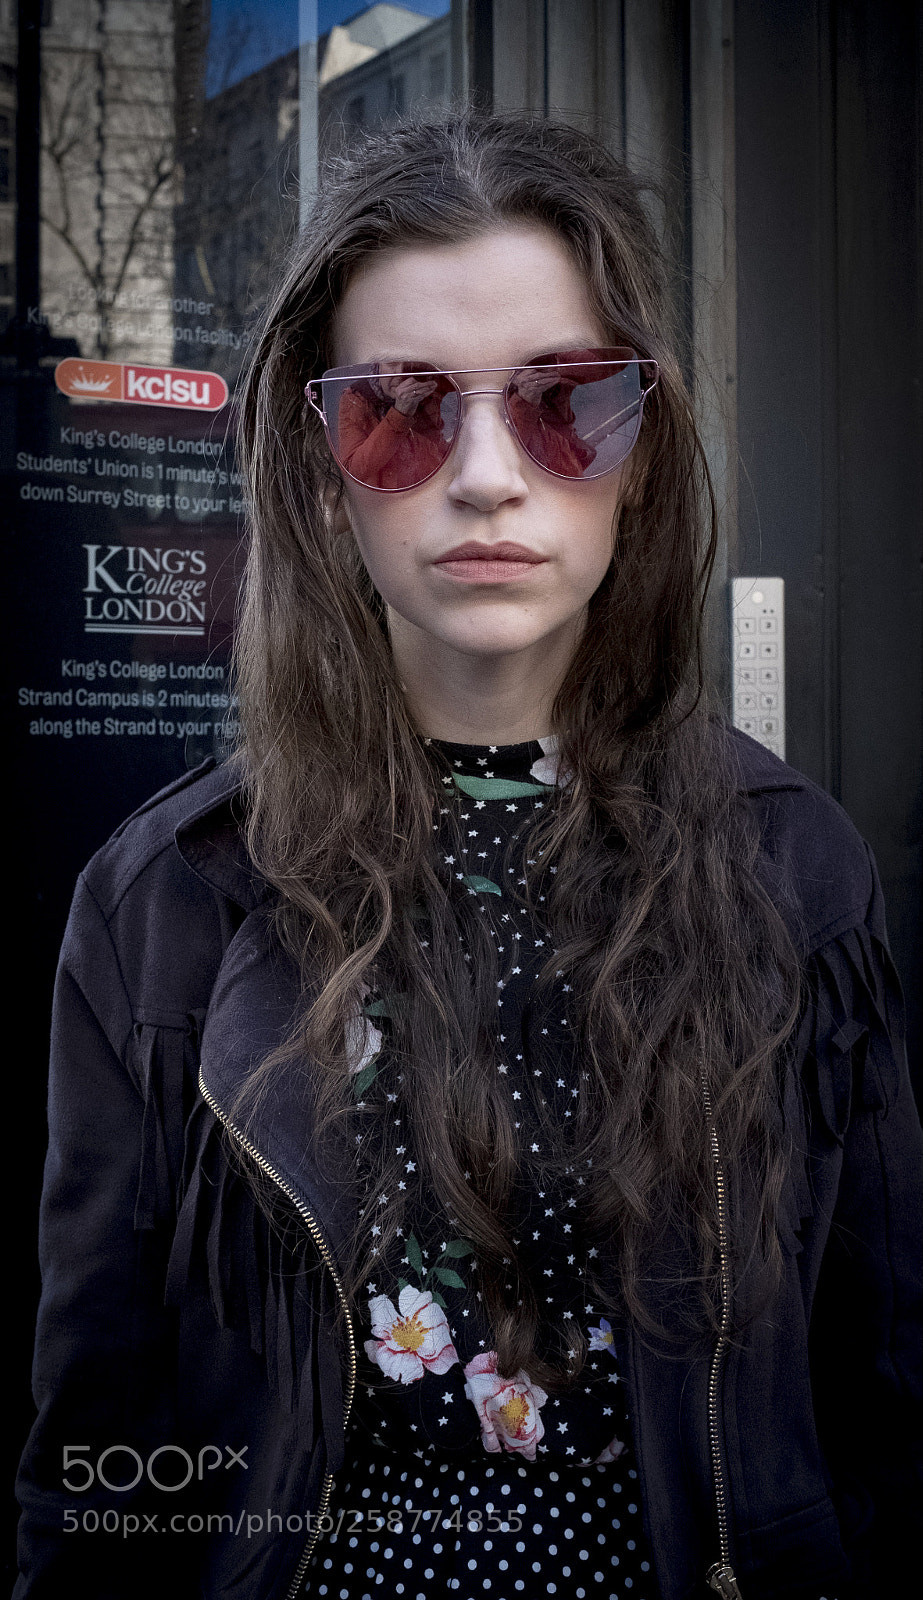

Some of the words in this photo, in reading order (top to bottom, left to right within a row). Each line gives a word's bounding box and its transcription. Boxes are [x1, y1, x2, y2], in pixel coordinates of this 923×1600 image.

[127, 370, 210, 405] kclsu
[60, 427, 106, 449] King's
[108, 430, 166, 454] College
[168, 436, 223, 456] London
[16, 452, 92, 475] Students'
[95, 458, 138, 478] Union
[141, 461, 155, 479] is
[156, 464, 164, 479] 1
[166, 465, 228, 485] minute's
[20, 483, 63, 501] down
[66, 485, 121, 508] Surrey
[124, 489, 171, 508] Street
[174, 494, 189, 510] to
[192, 499, 227, 514] your
[82, 543, 206, 594] KING'S
[126, 572, 206, 603] College
[84, 597, 206, 622] LONDON
[61, 659, 107, 681] King's
[110, 660, 166, 681] College
[169, 662, 224, 680] London
[18, 687, 73, 706] Strand
[75, 689, 139, 709] Campus
[142, 690, 155, 707] is
[157, 690, 167, 706] 2
[170, 690, 229, 708] minutes
[29, 717, 73, 738] along
[76, 717, 101, 735] the
[104, 717, 156, 735] Strand
[159, 719, 174, 735] to
[177, 722, 211, 738] your
